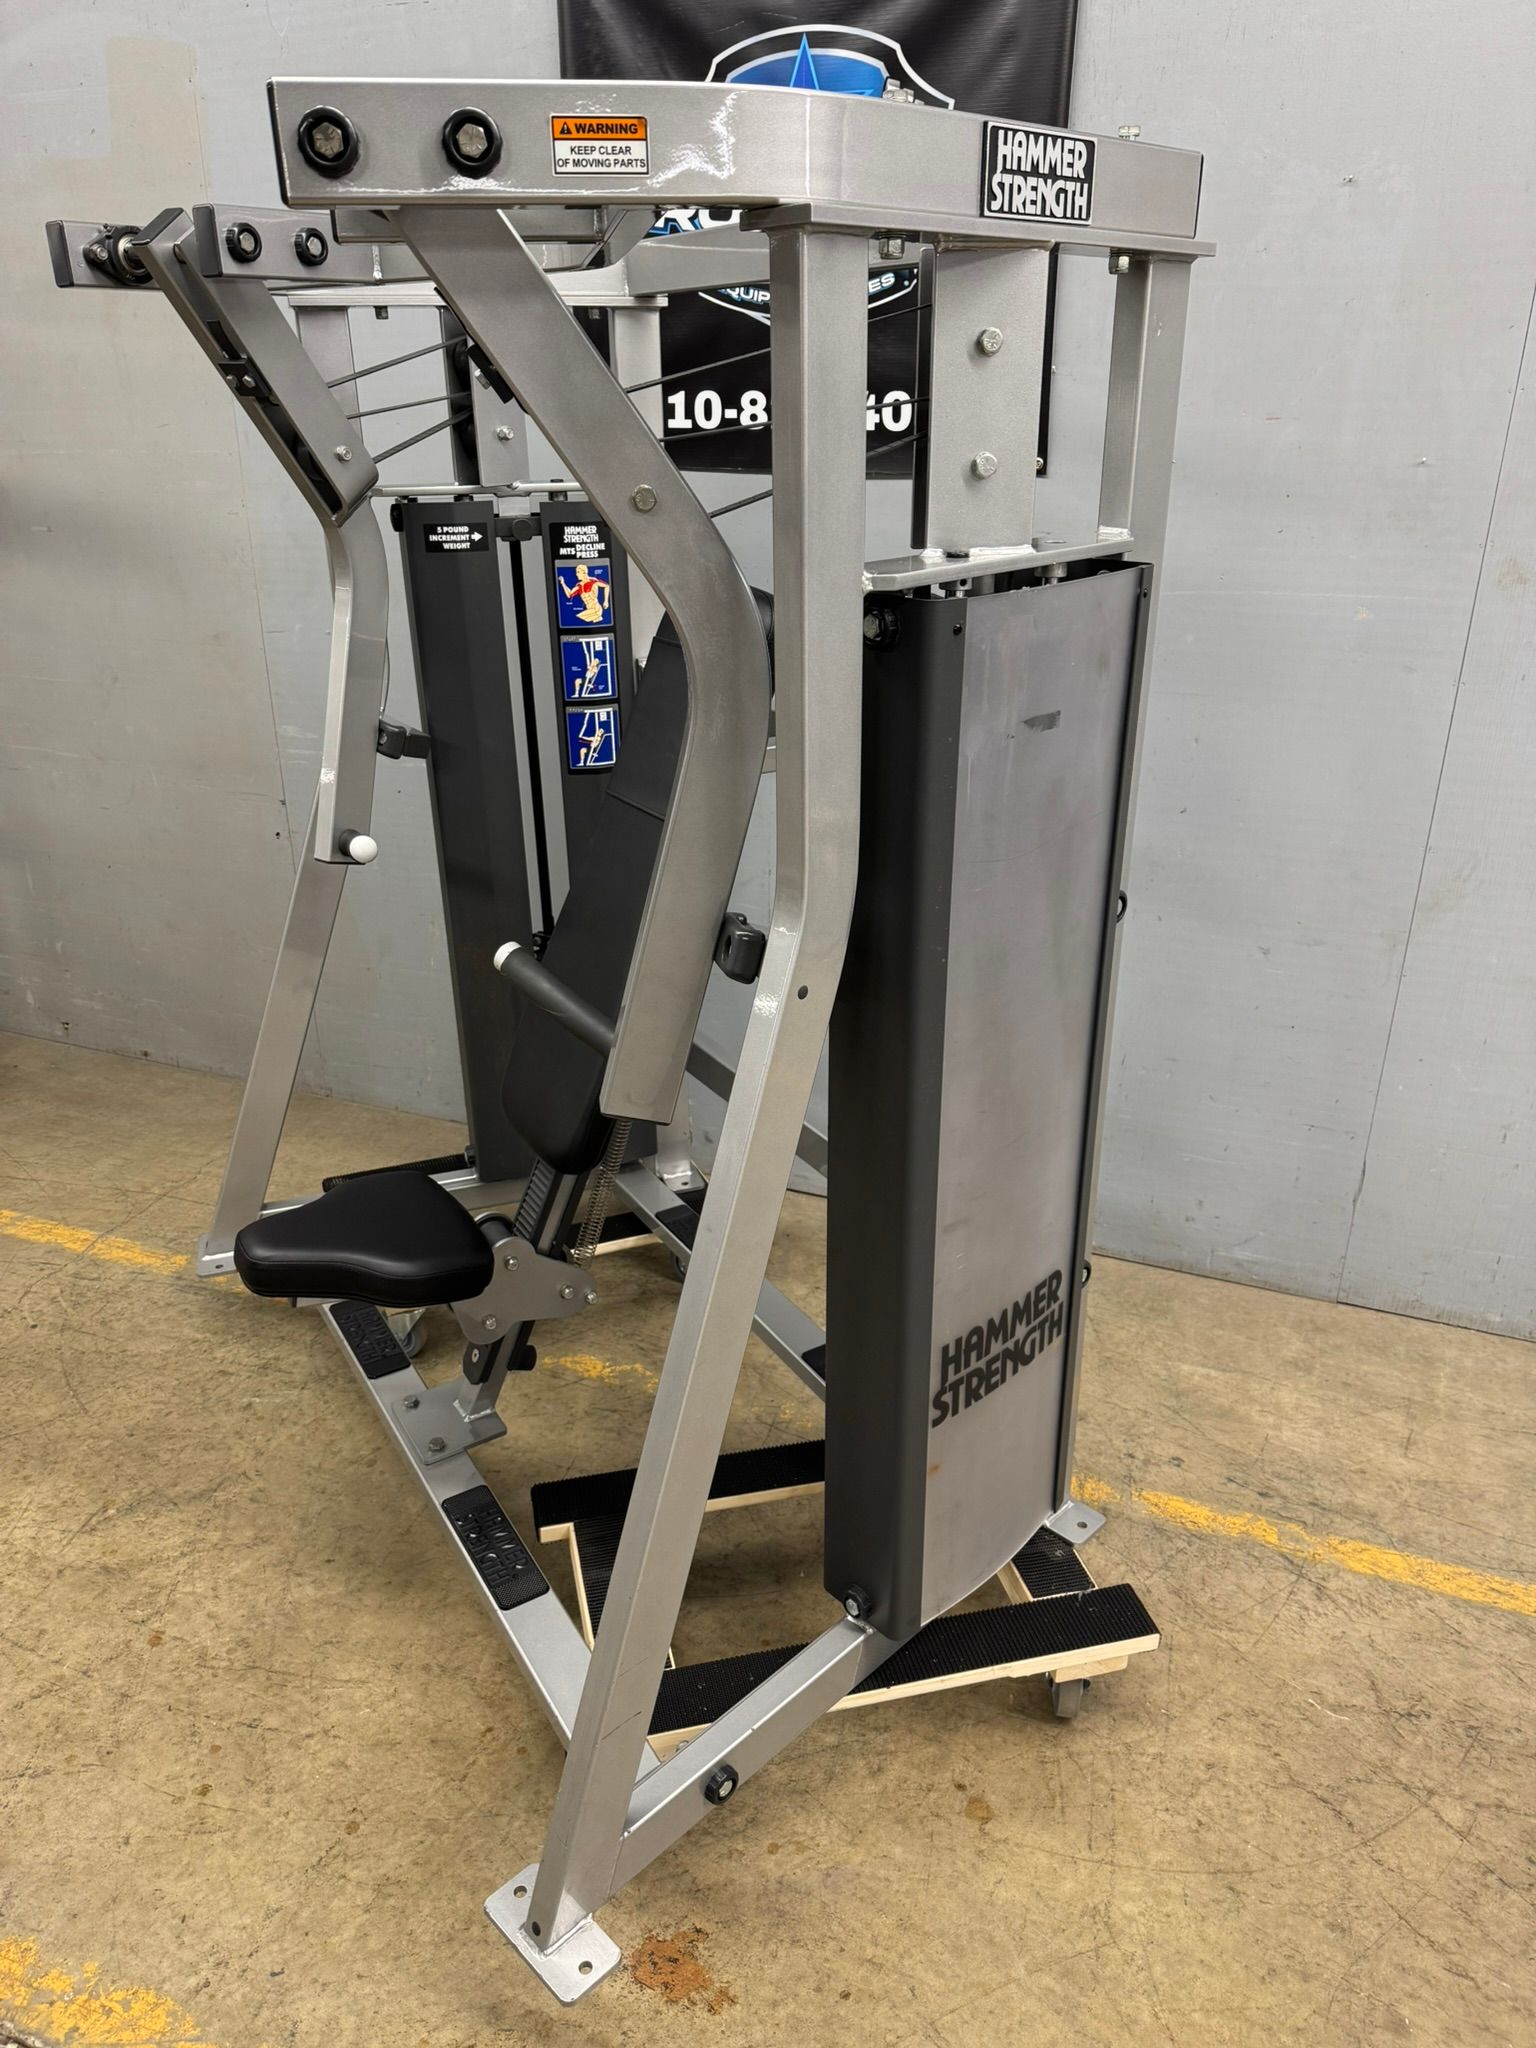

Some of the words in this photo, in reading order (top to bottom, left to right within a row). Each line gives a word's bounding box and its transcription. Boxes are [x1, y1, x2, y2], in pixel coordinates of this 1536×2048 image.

[574, 123, 638, 134] WARNING
[570, 145, 597, 155] KEEP
[598, 145, 632, 155] CLEAR
[997, 129, 1087, 179] HAMMER
[557, 158, 570, 168] OF
[572, 158, 611, 168] MOVING
[613, 158, 646, 168] PARTS
[991, 173, 1088, 219] STRENGTH
[437, 526, 442, 534] 5
[564, 526, 597, 535] HAMMER
[563, 534, 599, 543] STRENGTH
[560, 547, 575, 555] MTS
[576, 543, 605, 551] DECLINE
[576, 550, 599, 558] PRESS
[941, 1269, 1062, 1390] HAMMER
[932, 1301, 1063, 1428] STRENGTH
